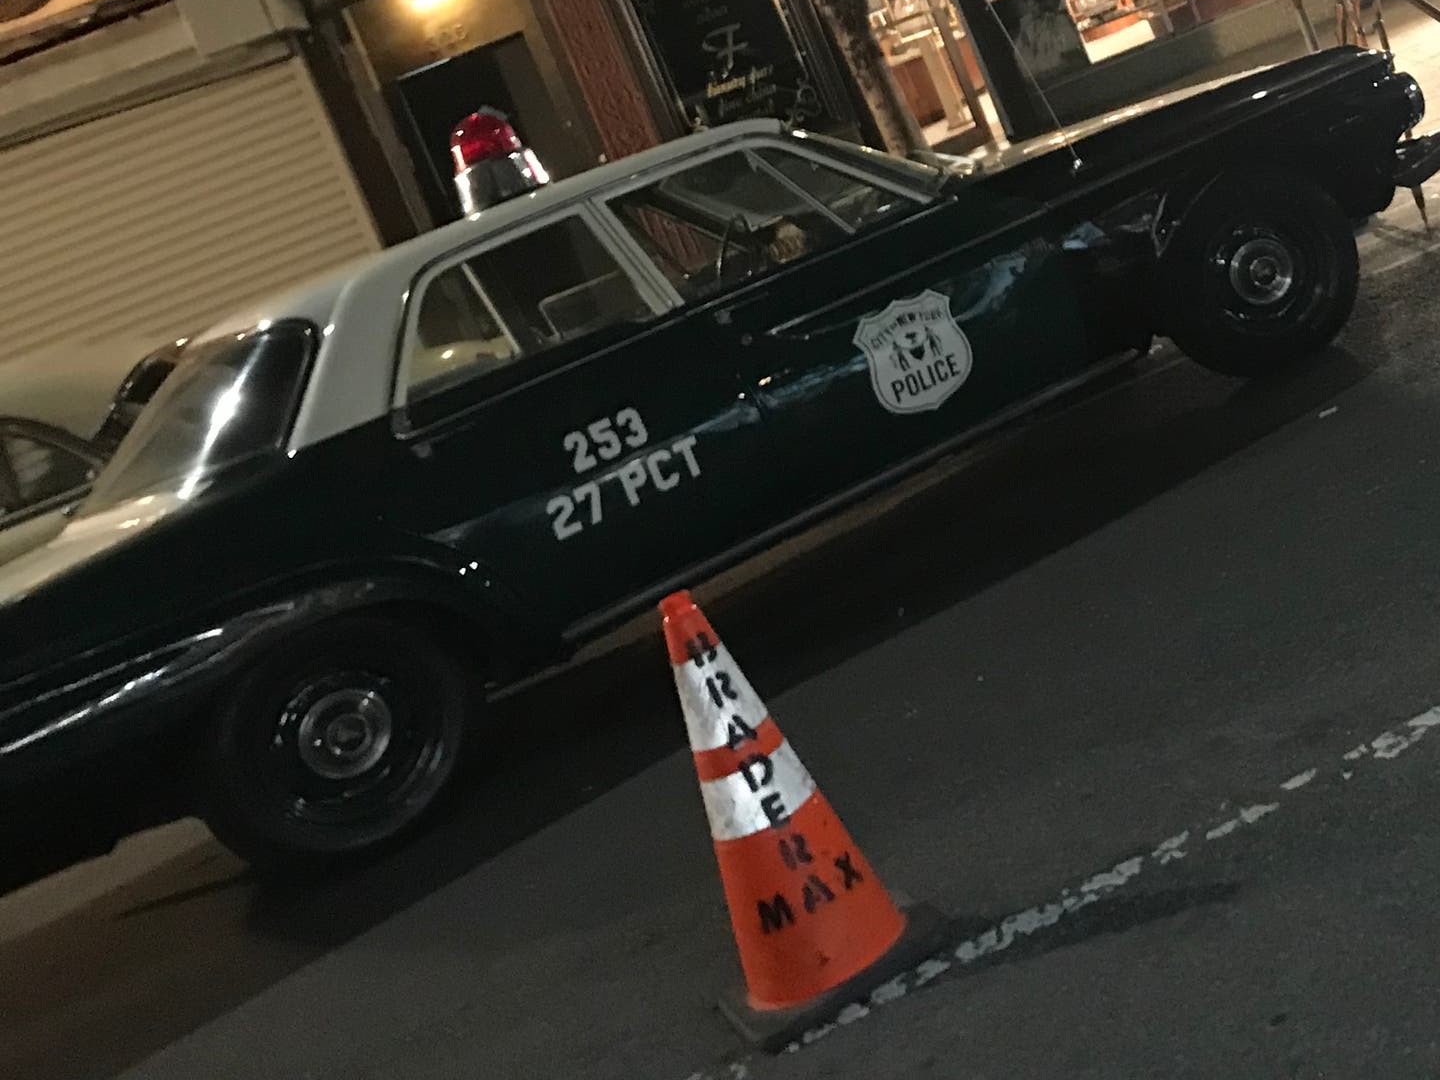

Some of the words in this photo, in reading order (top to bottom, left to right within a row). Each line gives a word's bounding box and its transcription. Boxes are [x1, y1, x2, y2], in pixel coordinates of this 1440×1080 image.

[891, 352, 960, 403] POLICE
[563, 407, 648, 473] 253
[546, 480, 603, 541] 27
[617, 435, 701, 507] PCT
[755, 850, 864, 936] MAX
